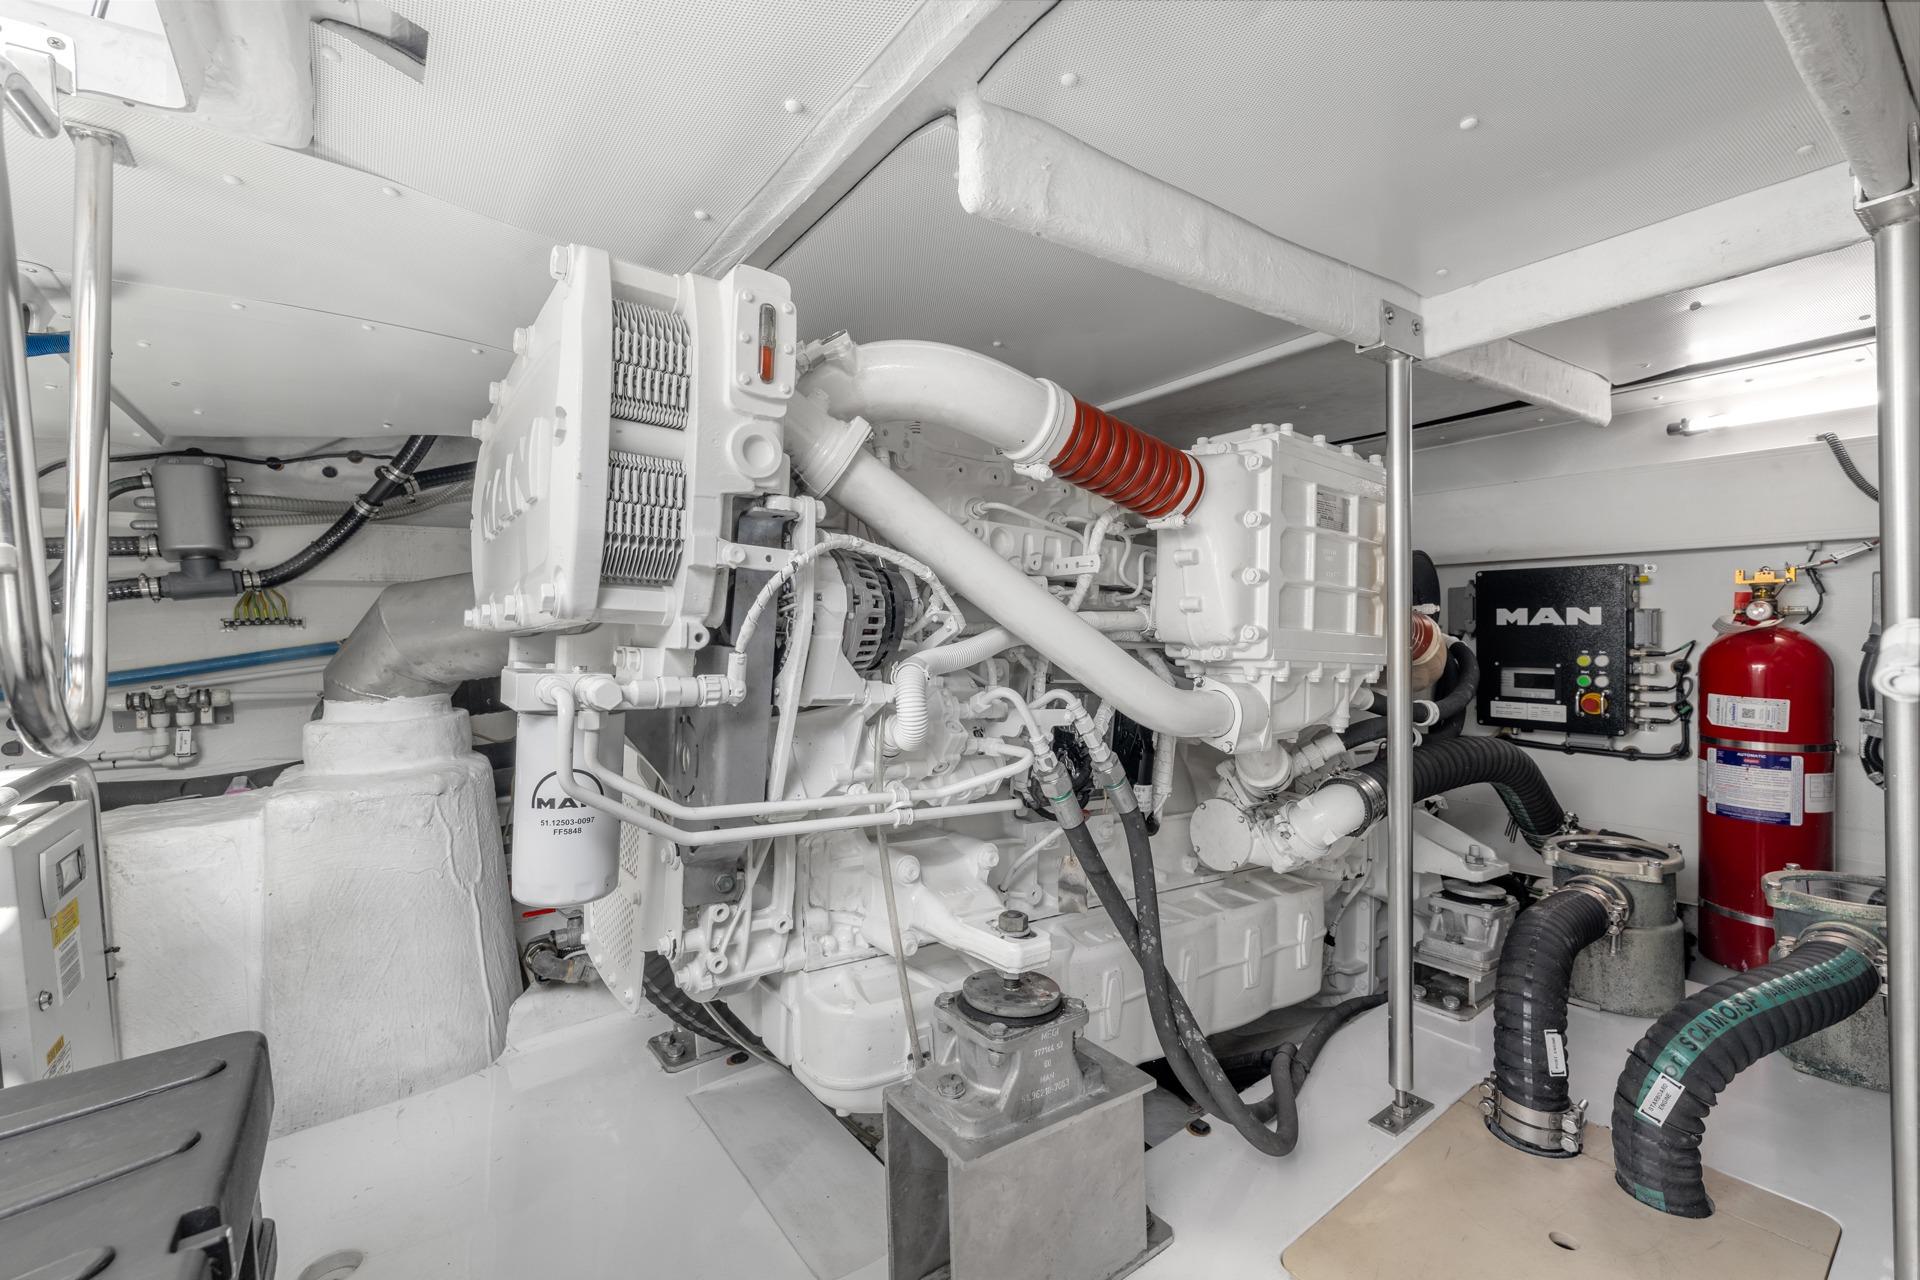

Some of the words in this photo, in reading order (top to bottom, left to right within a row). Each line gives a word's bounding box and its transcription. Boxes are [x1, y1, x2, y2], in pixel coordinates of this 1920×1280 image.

[1496, 606, 1602, 626] MAN
[536, 797, 587, 810] MA
[540, 816, 596, 827] 51.12503-0097
[553, 828, 582, 836] FF5848
[1648, 1083, 1668, 1112] STARBOARD
[1658, 1093, 1672, 1111] ENGINE
